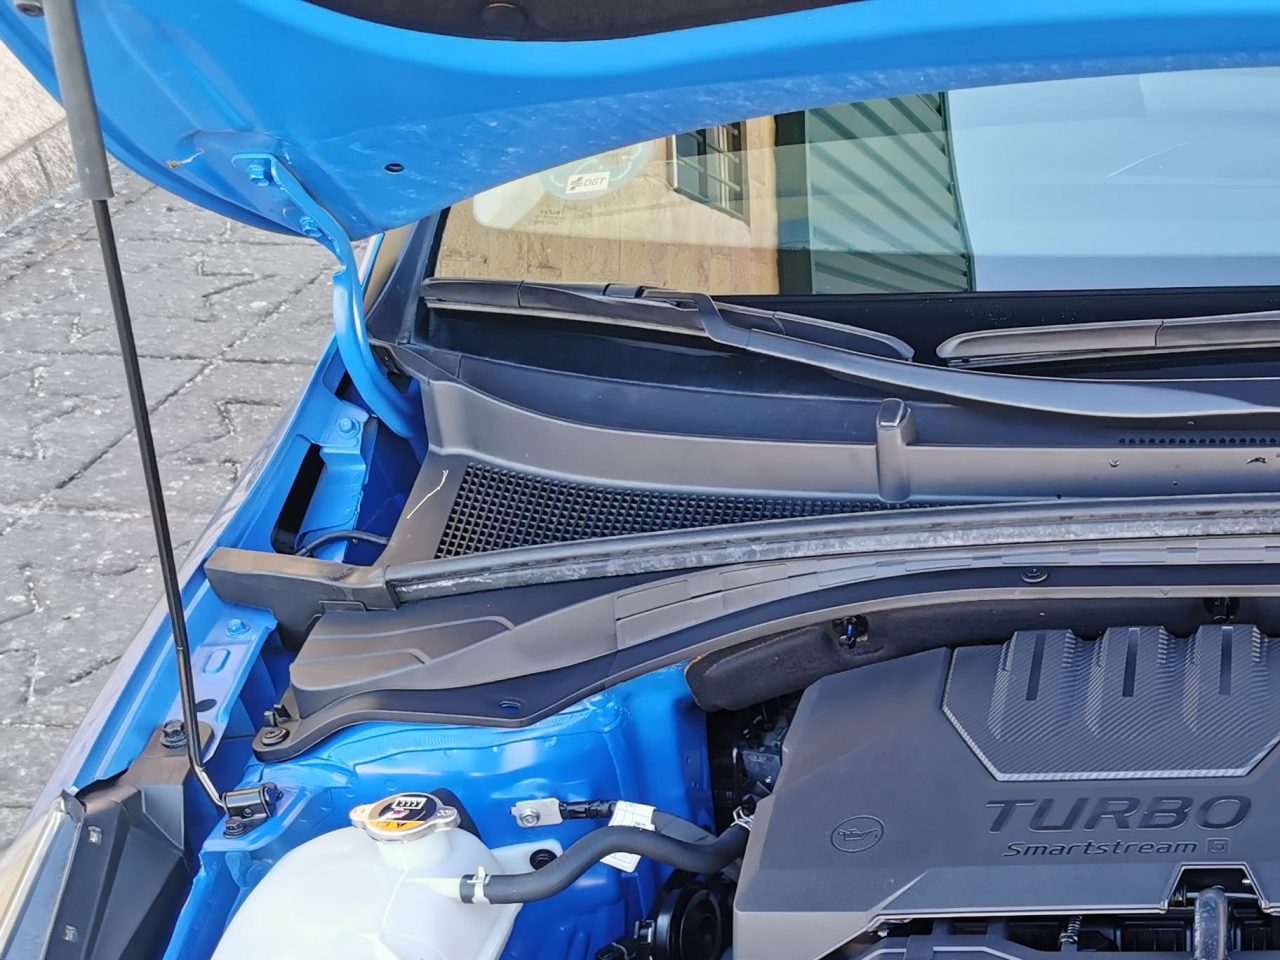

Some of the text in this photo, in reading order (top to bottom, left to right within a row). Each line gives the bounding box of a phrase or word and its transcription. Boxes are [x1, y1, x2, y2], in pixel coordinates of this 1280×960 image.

[583, 177, 607, 187] DGT
[984, 795, 1252, 834] TURBO
[1000, 840, 1198, 857] Smartstream
